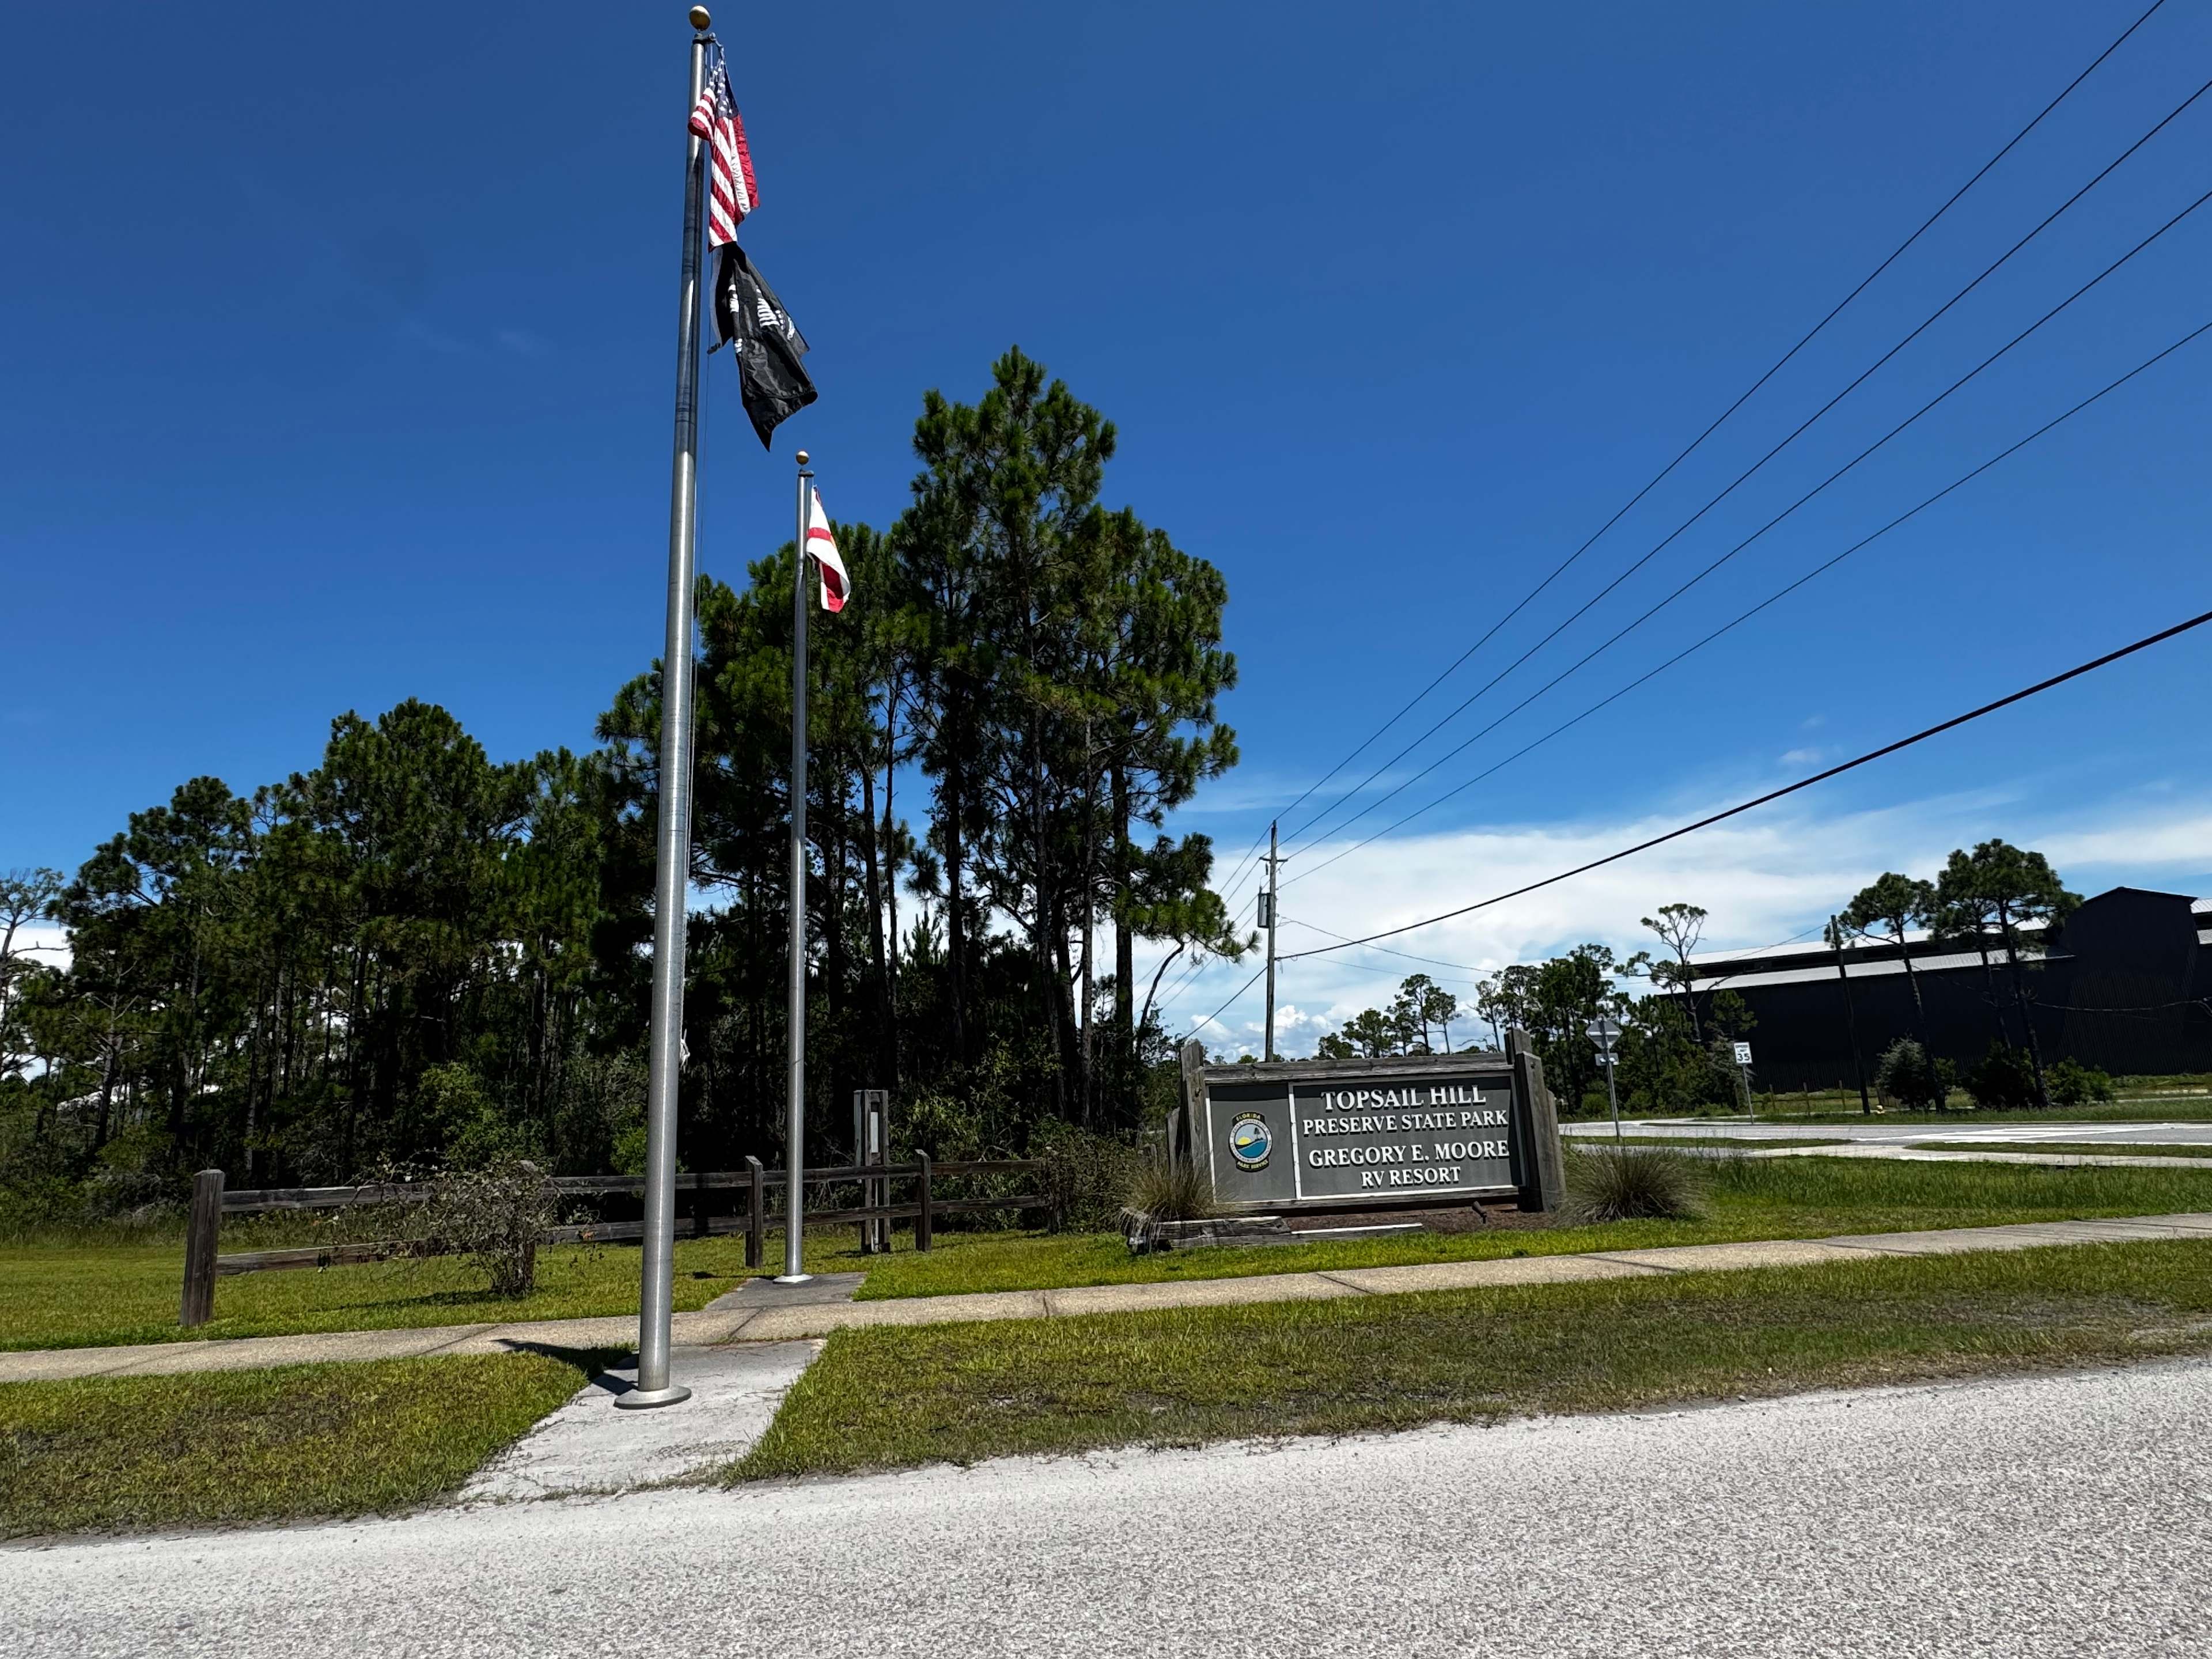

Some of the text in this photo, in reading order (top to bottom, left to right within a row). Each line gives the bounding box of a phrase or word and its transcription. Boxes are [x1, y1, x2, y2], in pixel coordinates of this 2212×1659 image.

[1321, 1085, 1486, 1110] TOPSAIL HILL
[1303, 1109, 1508, 1135] PRESERVE STATE PARK
[1309, 1139, 1509, 1166] GREGORY E. MOORE
[1361, 1166, 1461, 1187] RV RESORT
